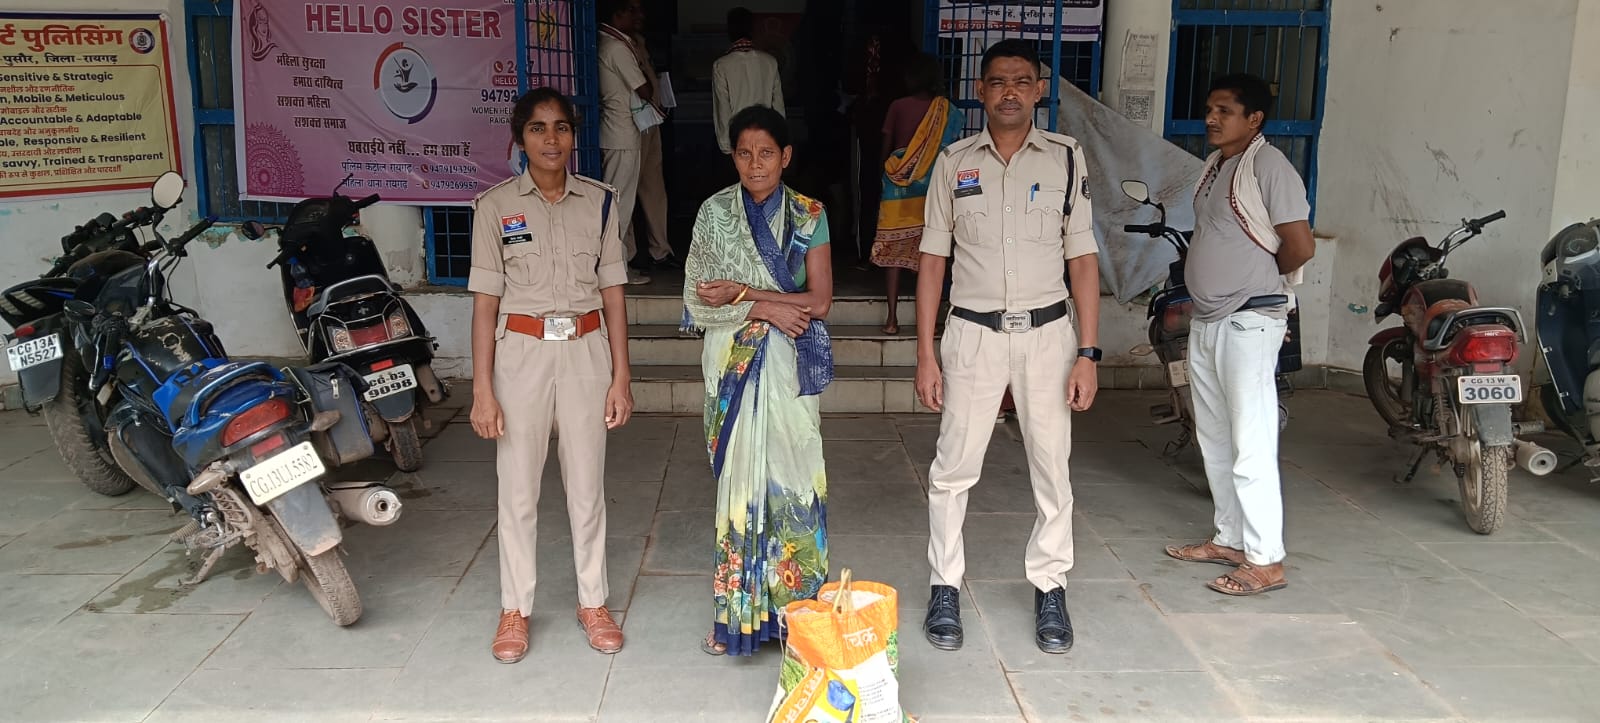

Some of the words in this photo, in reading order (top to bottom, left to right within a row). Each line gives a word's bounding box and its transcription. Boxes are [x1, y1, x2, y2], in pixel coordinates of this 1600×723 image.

[305, 4, 393, 34] HELLO
[402, 7, 502, 38] SISTER
[21, 24, 123, 52] पुलिसिंग
[277, 53, 299, 66] महिला
[302, 57, 326, 71] सुरक्षा
[63, 71, 113, 82] Strategic
[293, 76, 312, 87] हमारा
[314, 76, 343, 89] दायित्व
[496, 77, 517, 85] HELLO
[25, 84, 38, 92] और
[13, 94, 52, 103] Mobile
[66, 92, 125, 102] Meticulous
[277, 96, 304, 107] सशक्त
[307, 95, 330, 108] महिला
[32, 106, 44, 114] और
[472, 106, 498, 115] WOMEN
[0, 115, 73, 125] Accountable
[75, 114, 83, 122] &
[86, 112, 142, 124] Adaptable
[294, 116, 321, 128] सशक्त
[323, 118, 346, 129] समाज
[489, 117, 513, 125] RAIGA
[24, 135, 88, 147] Responsive
[91, 134, 99, 142] &
[101, 132, 146, 142] Resilient
[43, 147, 55, 155] और
[423, 144, 437, 155] हम
[441, 144, 460, 156] साथ
[461, 141, 471, 156] हैं
[3, 159, 40, 169] savvy,
[43, 156, 85, 166] Trained
[88, 155, 96, 164] &
[99, 152, 163, 164] Transparent
[84, 166, 96, 174] और
[367, 179, 382, 188] थाना
[430, 180, 478, 190] 9479269957
[20, 346, 56, 366] N5527
[368, 379, 412, 398] 9098
[1464, 386, 1516, 401] 3060
